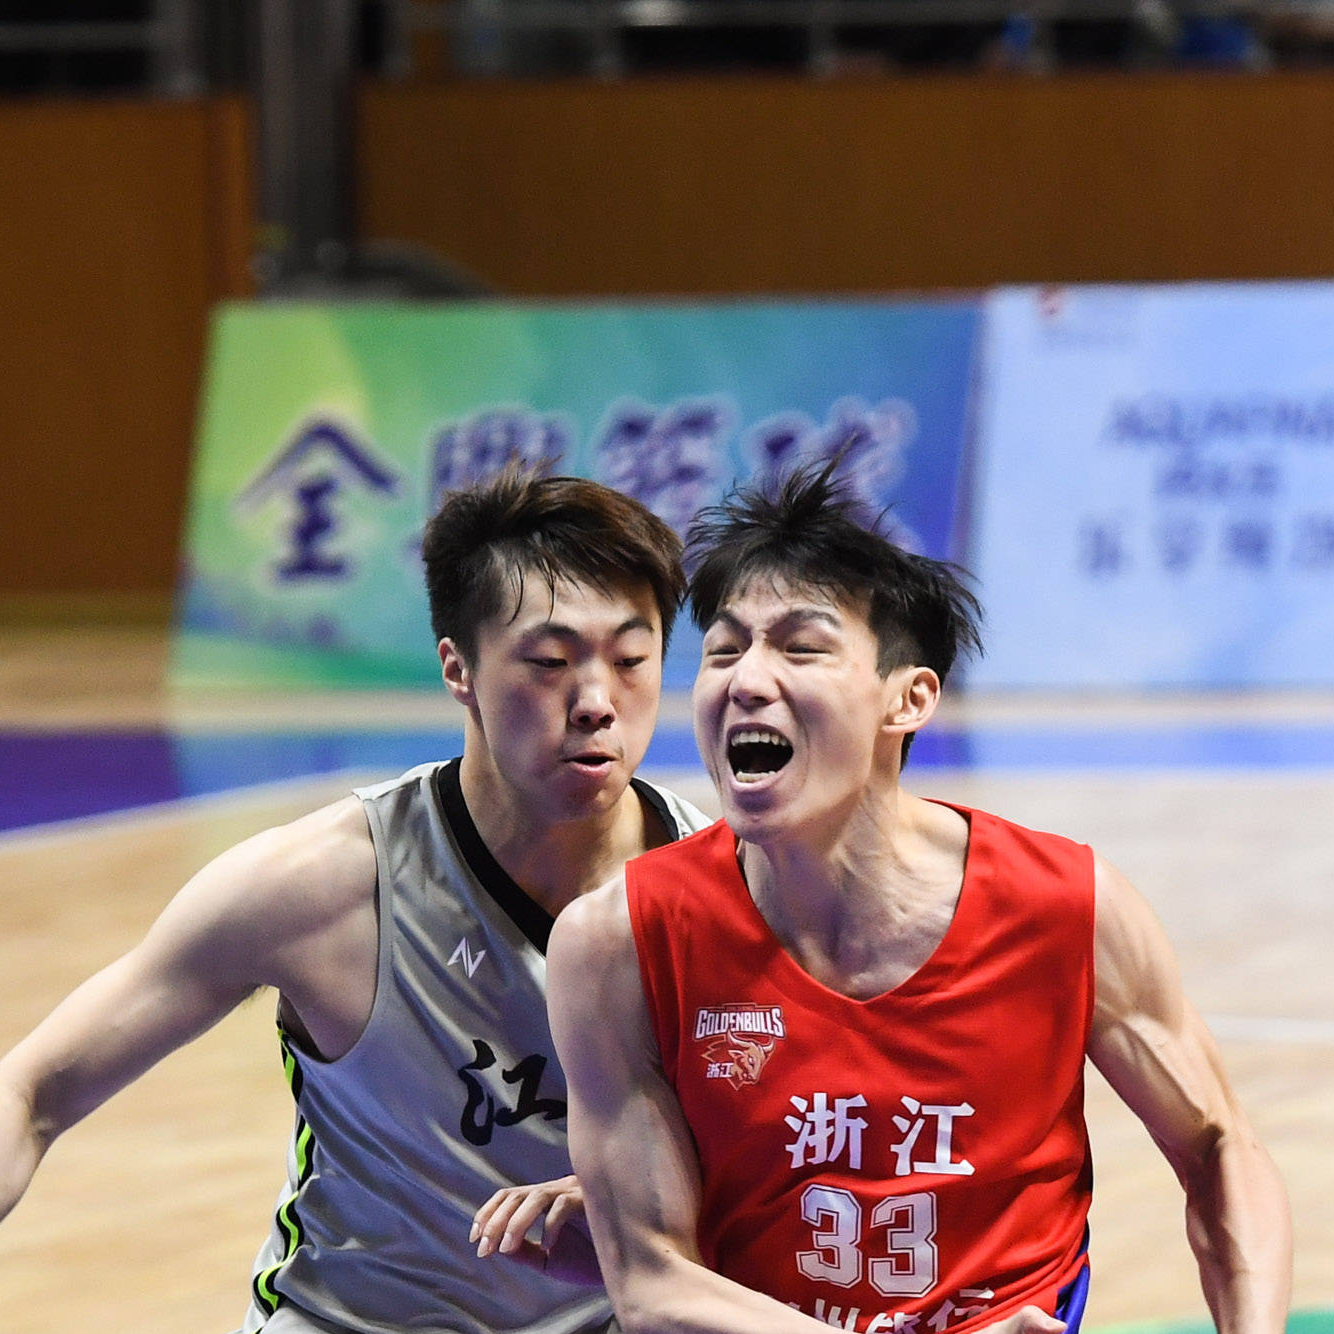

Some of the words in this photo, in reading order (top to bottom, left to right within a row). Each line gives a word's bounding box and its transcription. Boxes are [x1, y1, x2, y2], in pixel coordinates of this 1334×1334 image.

[694, 1007, 786, 1039] GOLDENBULLS
[784, 1092, 976, 1177] 浙江
[796, 1184, 939, 1298] 33
